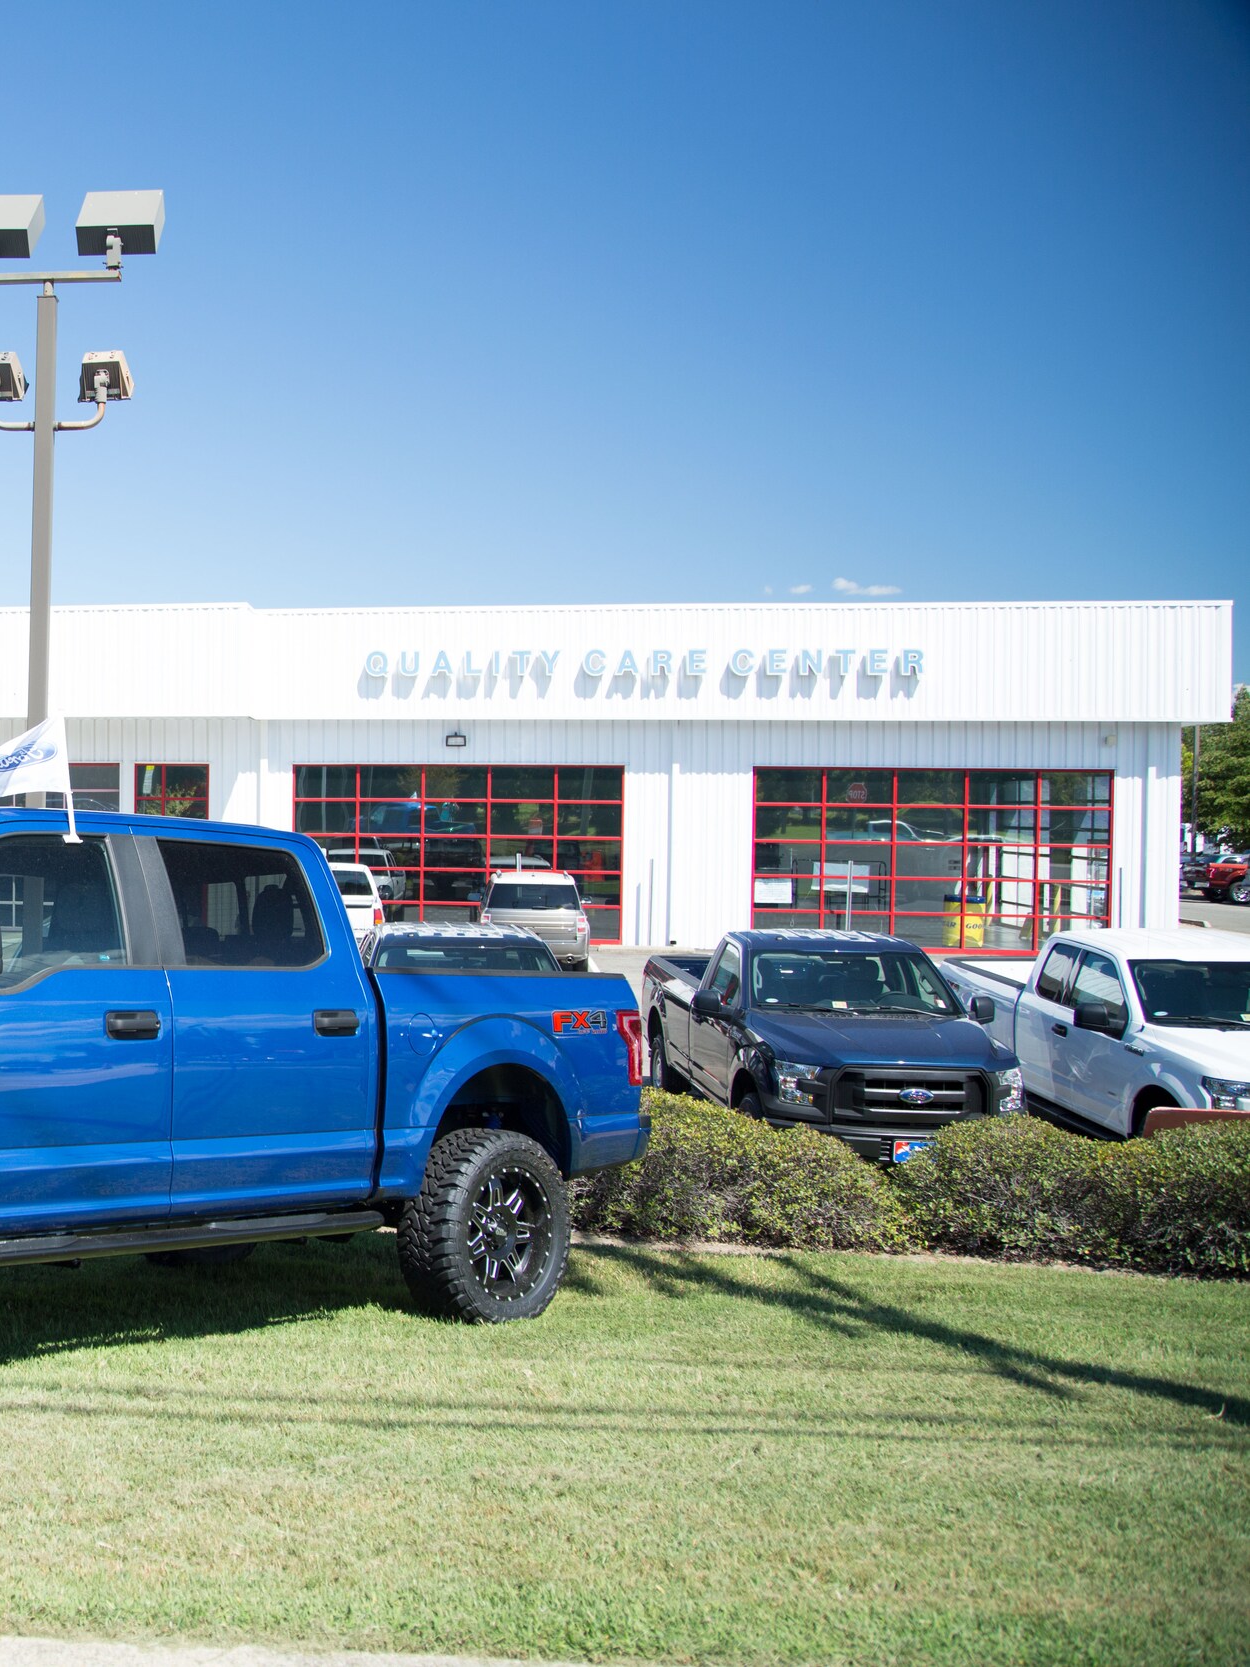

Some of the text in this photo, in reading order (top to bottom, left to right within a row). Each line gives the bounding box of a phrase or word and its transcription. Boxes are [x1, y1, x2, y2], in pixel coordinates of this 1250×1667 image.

[365, 649, 925, 676] QUALITY CARE CENTER
[551, 1009, 608, 1034] FX4
